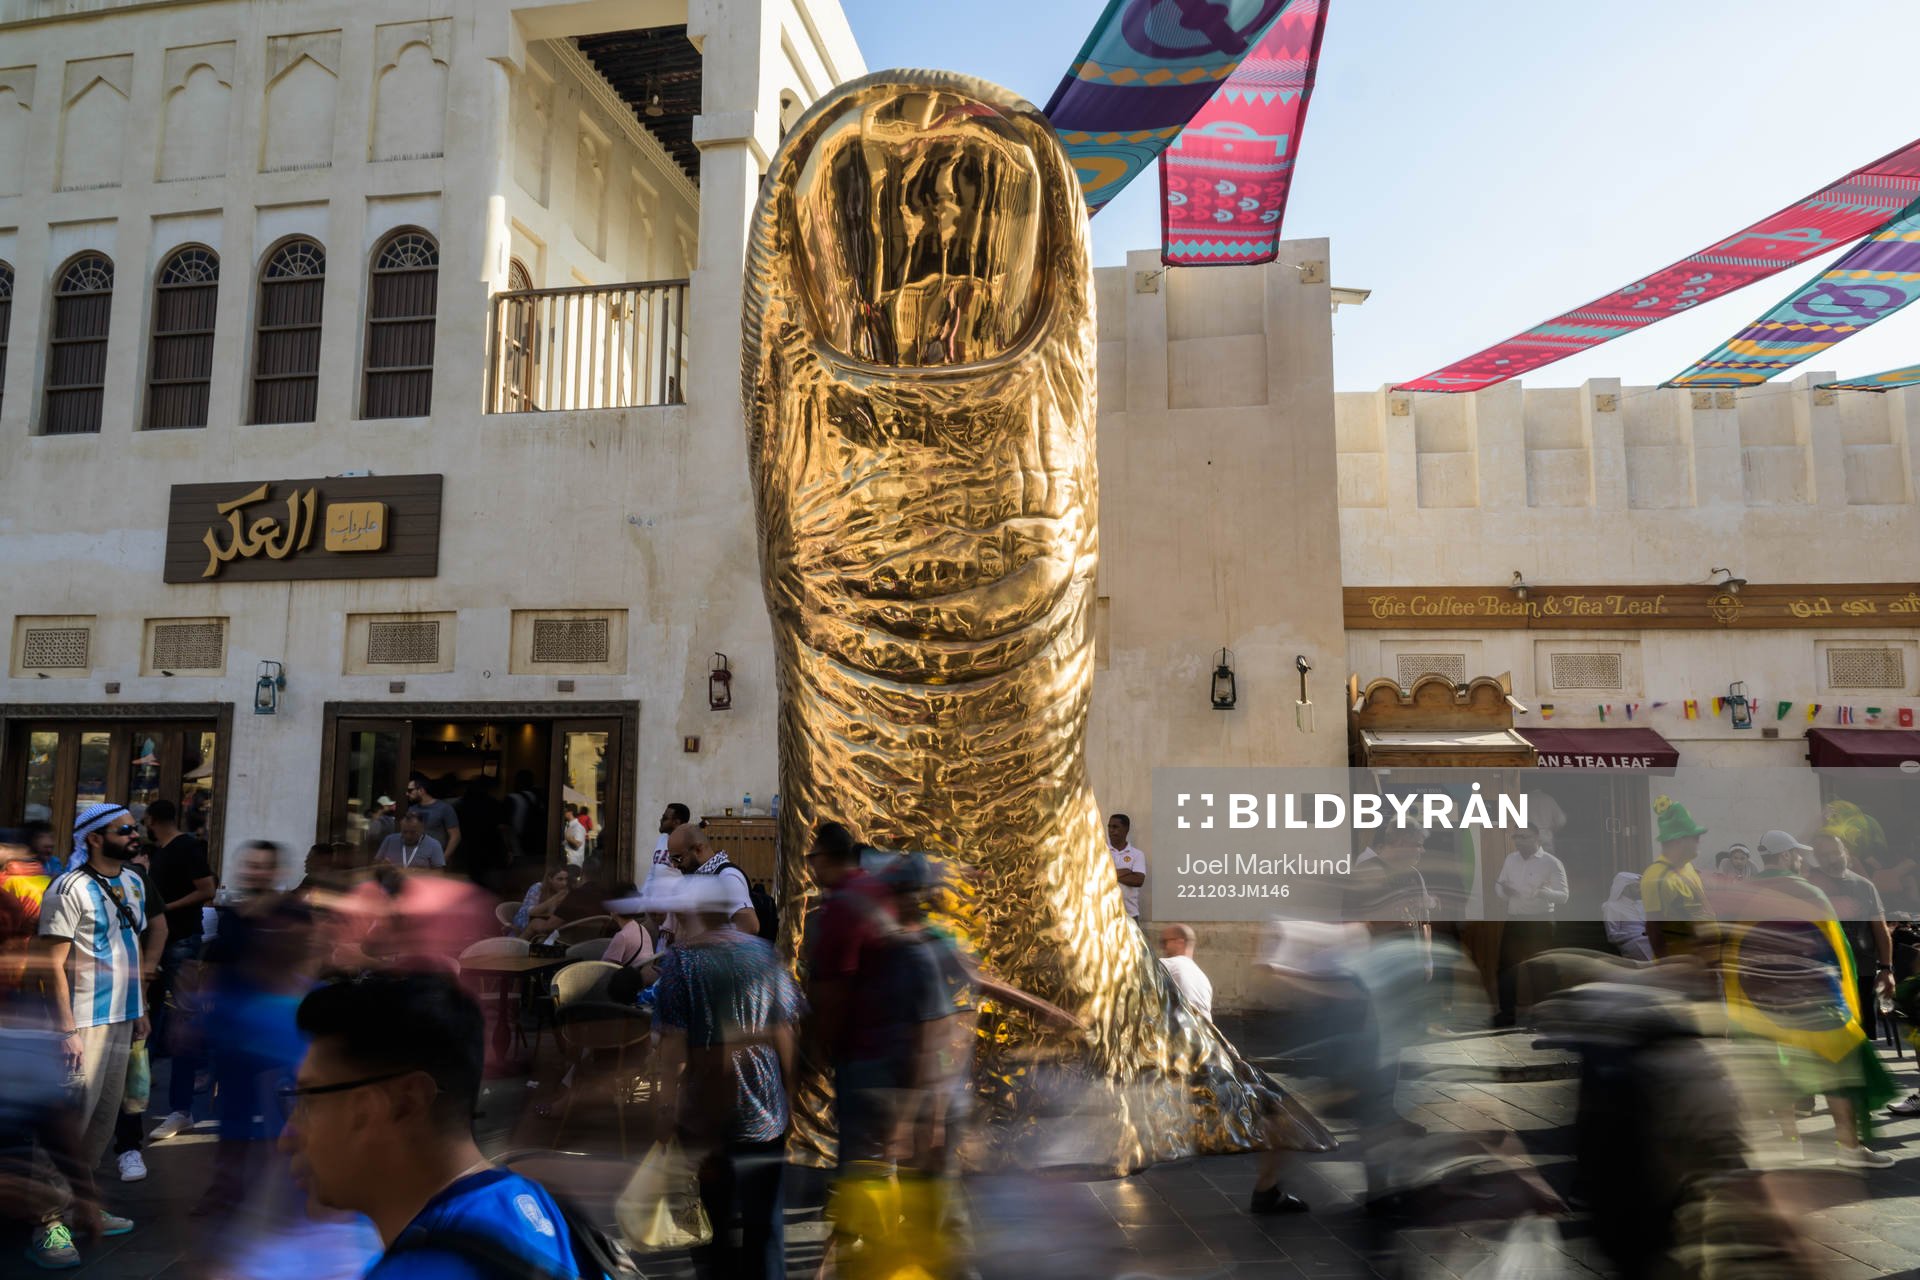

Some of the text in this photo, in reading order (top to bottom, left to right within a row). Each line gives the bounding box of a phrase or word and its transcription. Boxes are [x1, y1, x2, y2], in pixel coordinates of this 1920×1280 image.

[202, 483, 317, 577] العكر
[1368, 595, 1665, 619] The Coffee Bean & Tea Leaf
[1575, 756, 1607, 768] TEA
[1611, 756, 1651, 769] LEAF
